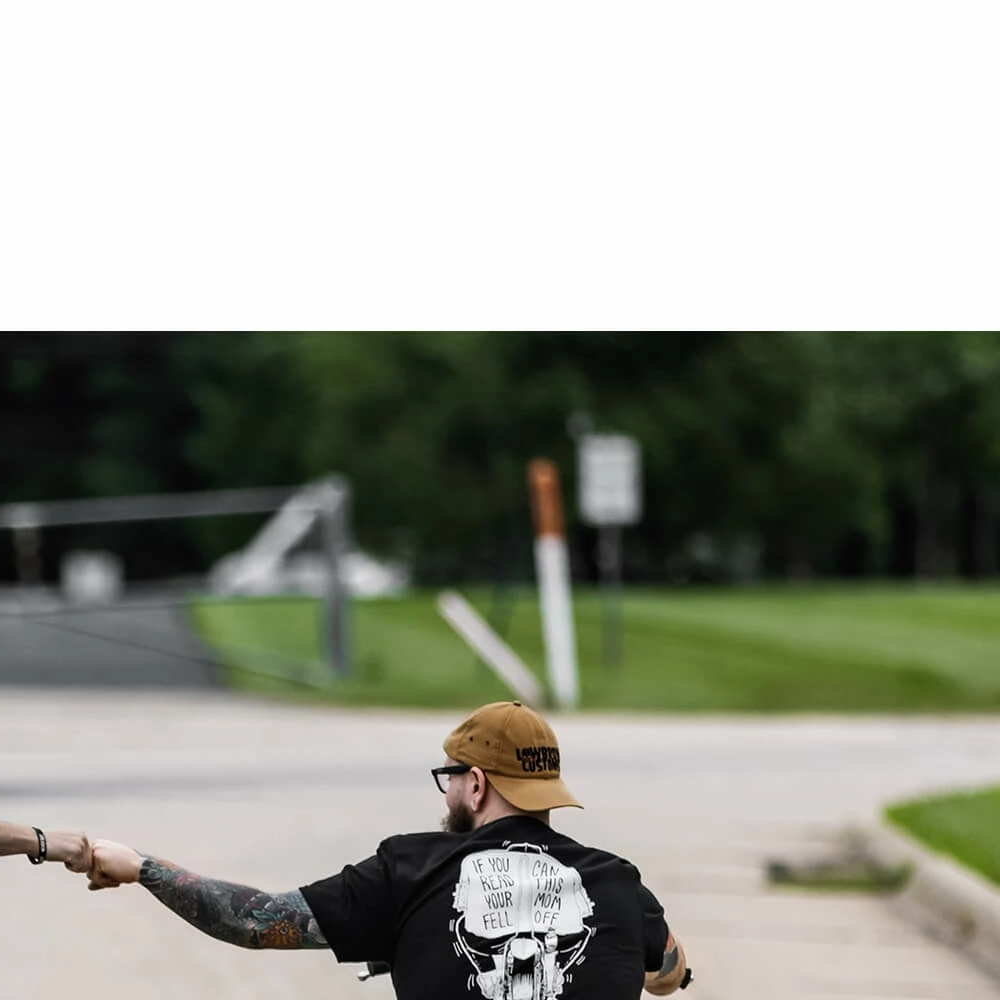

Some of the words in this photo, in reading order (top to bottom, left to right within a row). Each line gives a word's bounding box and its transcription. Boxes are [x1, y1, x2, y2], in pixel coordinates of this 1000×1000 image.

[472, 858, 483, 874] IF
[488, 857, 510, 873] YOU
[532, 860, 560, 877] CAN
[480, 874, 514, 892] READ
[535, 877, 564, 893] THIS
[484, 891, 513, 910] YOUR
[534, 892, 561, 910] MOM
[482, 911, 513, 930] FELL
[534, 910, 560, 926] OFF
